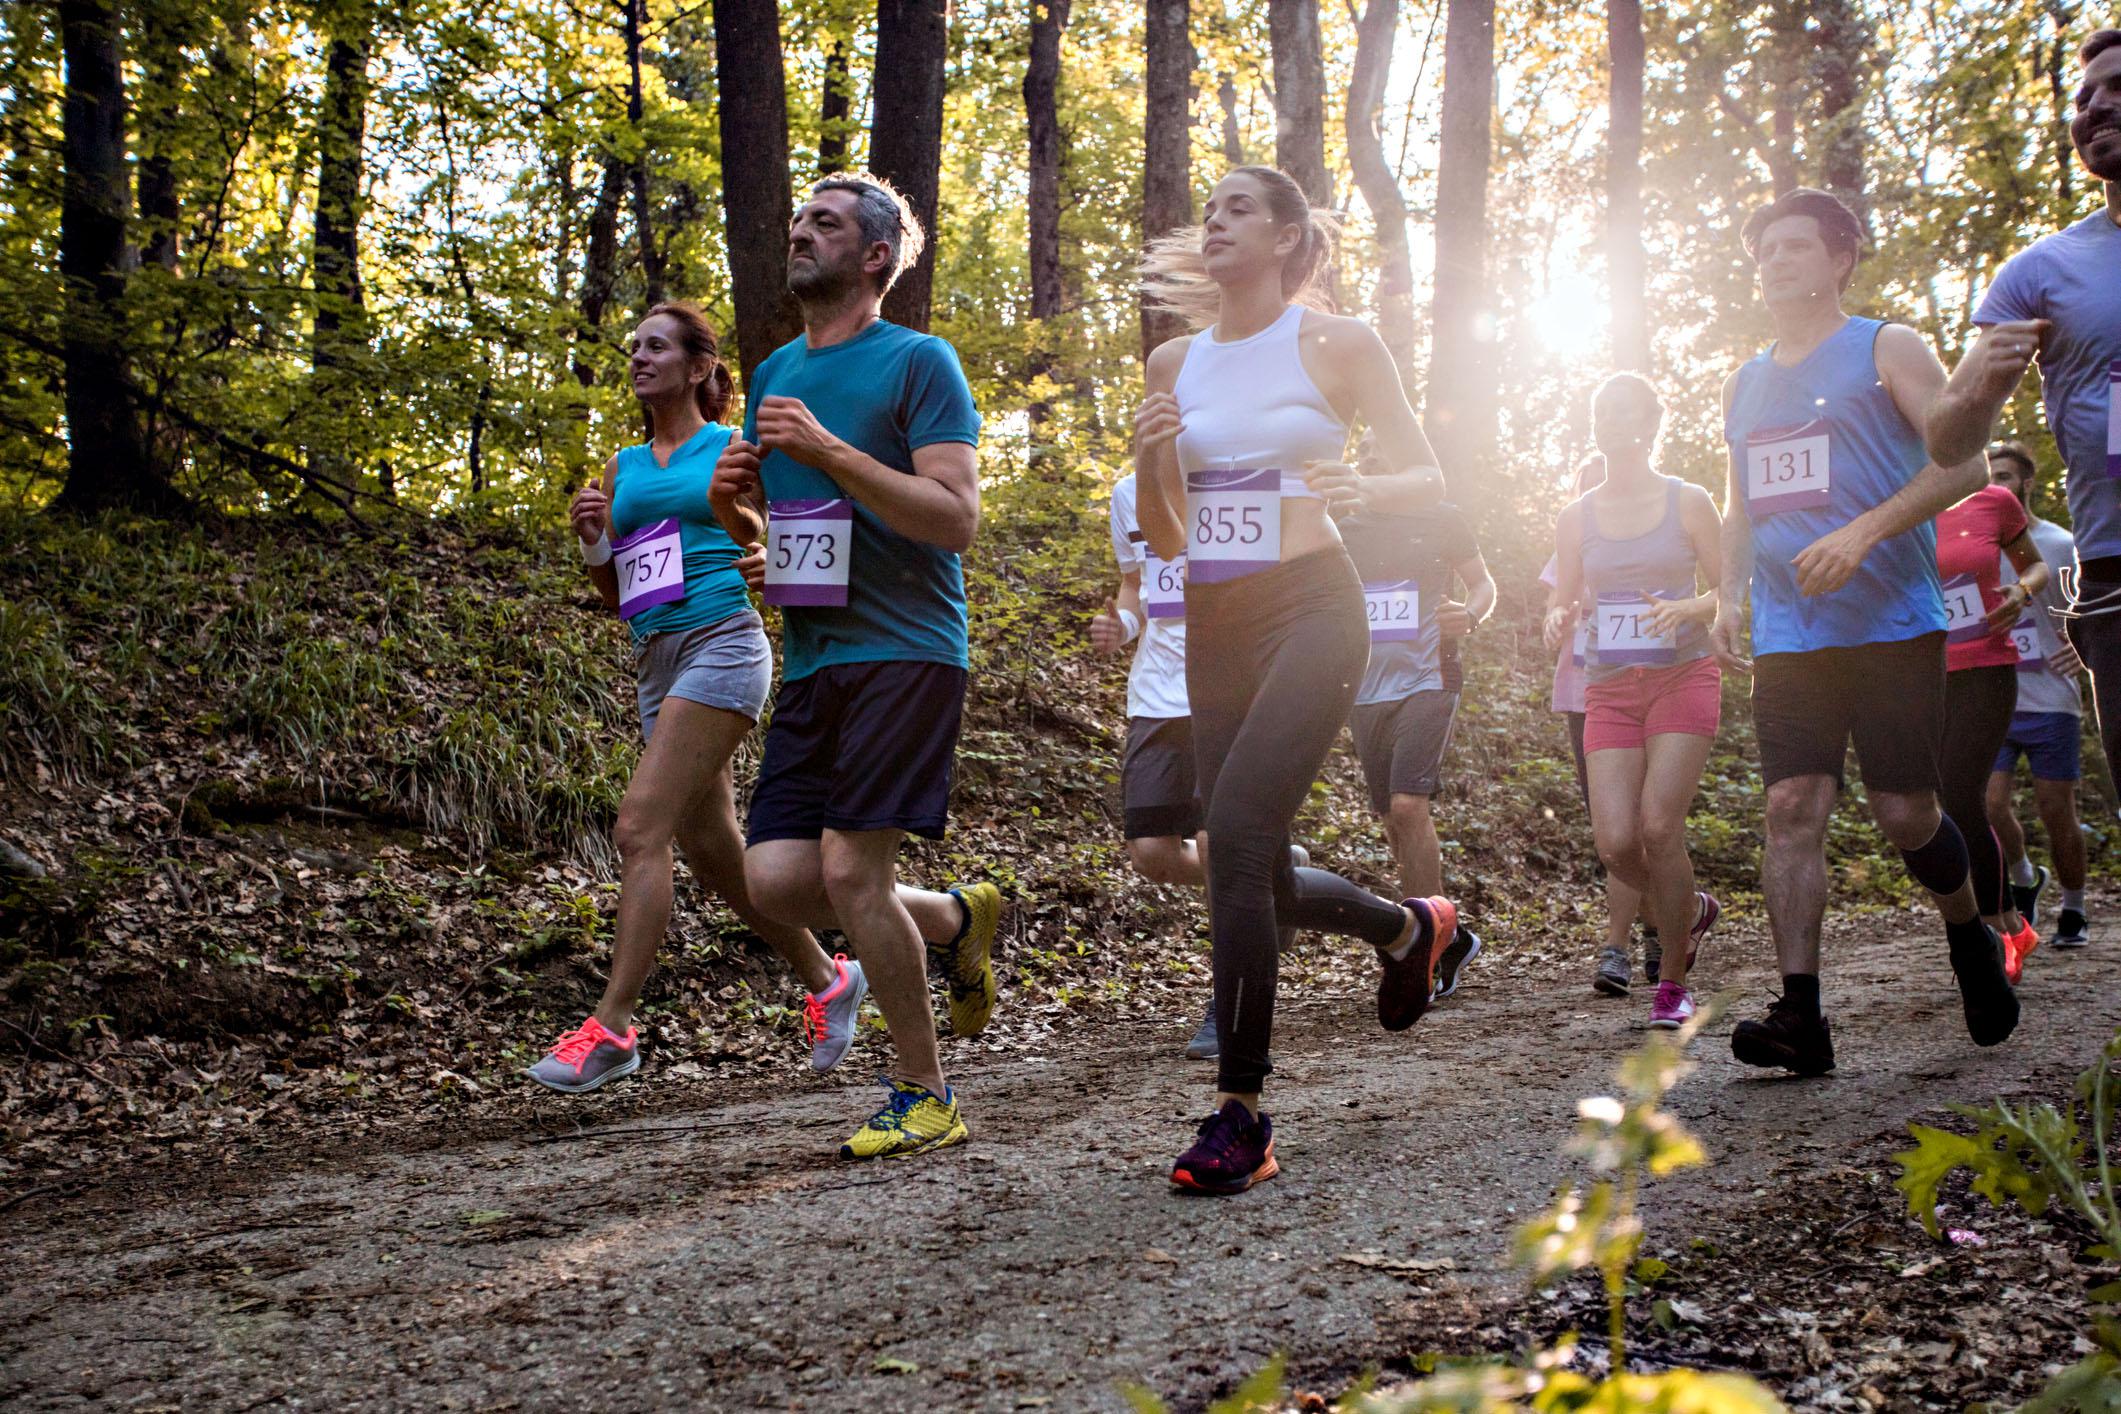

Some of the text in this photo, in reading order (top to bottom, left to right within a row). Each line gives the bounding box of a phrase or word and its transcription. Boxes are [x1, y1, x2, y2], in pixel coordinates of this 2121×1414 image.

[1760, 448, 1815, 485] 131
[1197, 507, 1263, 544] 855
[626, 547, 671, 590] 757
[776, 534, 835, 570] 573
[1367, 600, 1409, 622] 212
